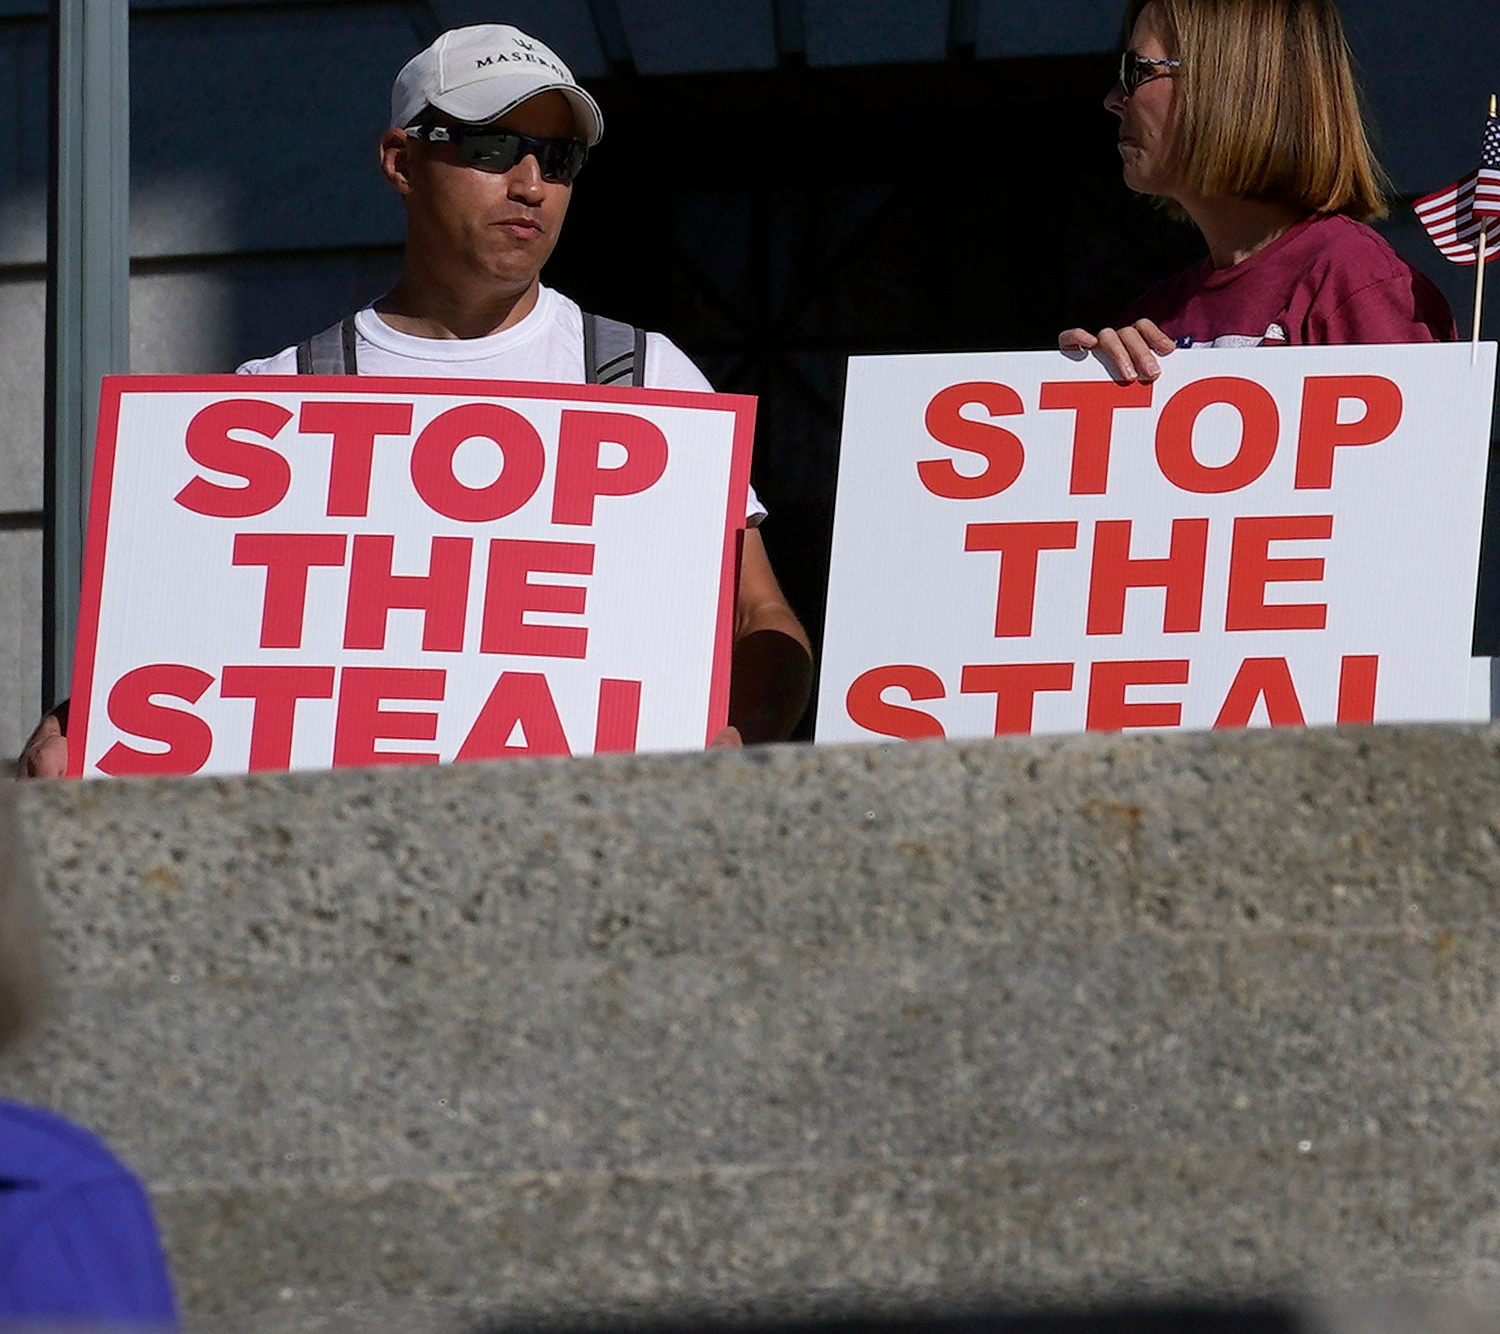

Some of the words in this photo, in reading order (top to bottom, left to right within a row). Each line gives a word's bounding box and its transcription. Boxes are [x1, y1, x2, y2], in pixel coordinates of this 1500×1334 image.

[175, 398, 669, 527] STOP
[916, 375, 1403, 500] STOP
[232, 533, 596, 660] THE
[964, 514, 1334, 638] THE
